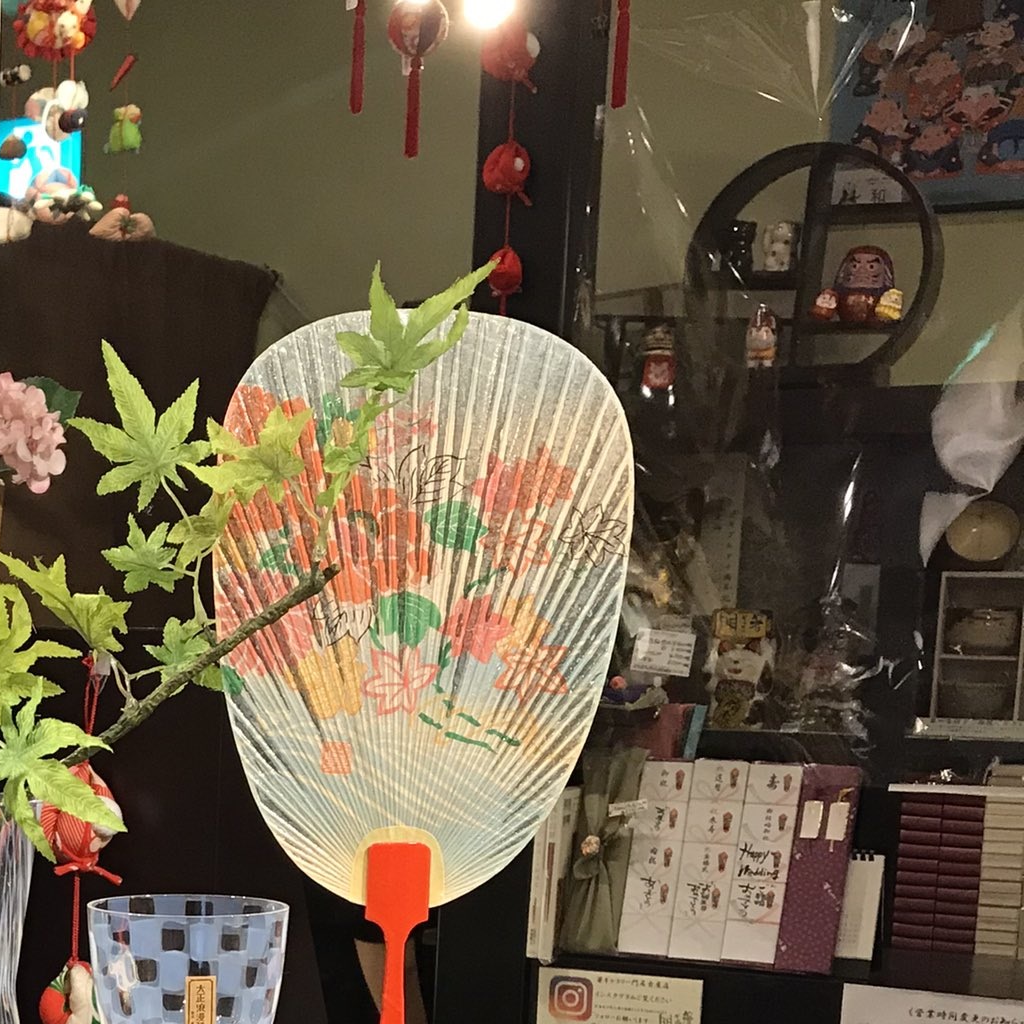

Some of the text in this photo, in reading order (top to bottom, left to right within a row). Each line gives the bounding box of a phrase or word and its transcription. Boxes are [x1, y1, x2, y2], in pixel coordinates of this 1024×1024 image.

[766, 773, 780, 790] 寿
[739, 842, 770, 864] Happy
[738, 864, 780, 880] Wedding
